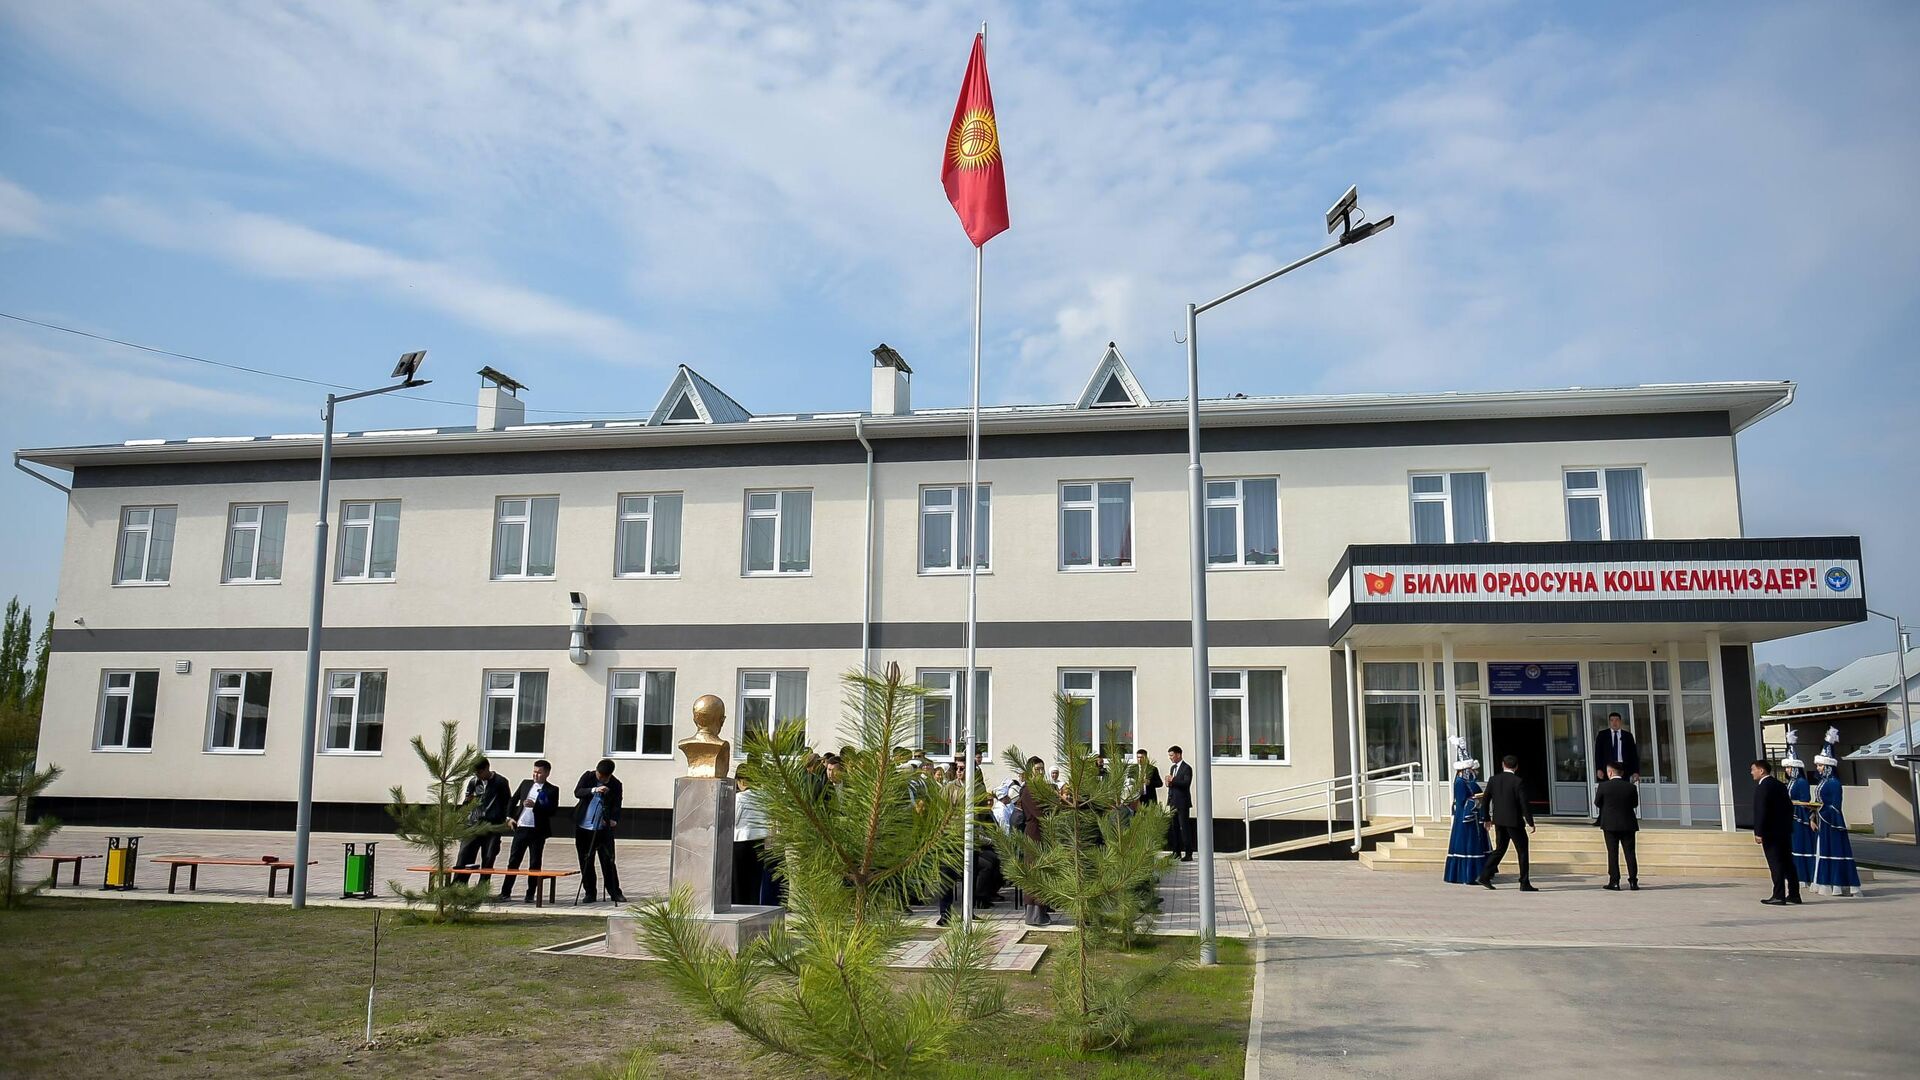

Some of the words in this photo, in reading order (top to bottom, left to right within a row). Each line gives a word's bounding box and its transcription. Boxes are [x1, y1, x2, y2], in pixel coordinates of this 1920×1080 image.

[1403, 573, 1477, 593] БИЛИМ
[1483, 572, 1598, 596] ОРДОСУНА
[1603, 570, 1655, 592] КОШ
[1661, 568, 1818, 593] КЕЛИҢИЗДЕР!
